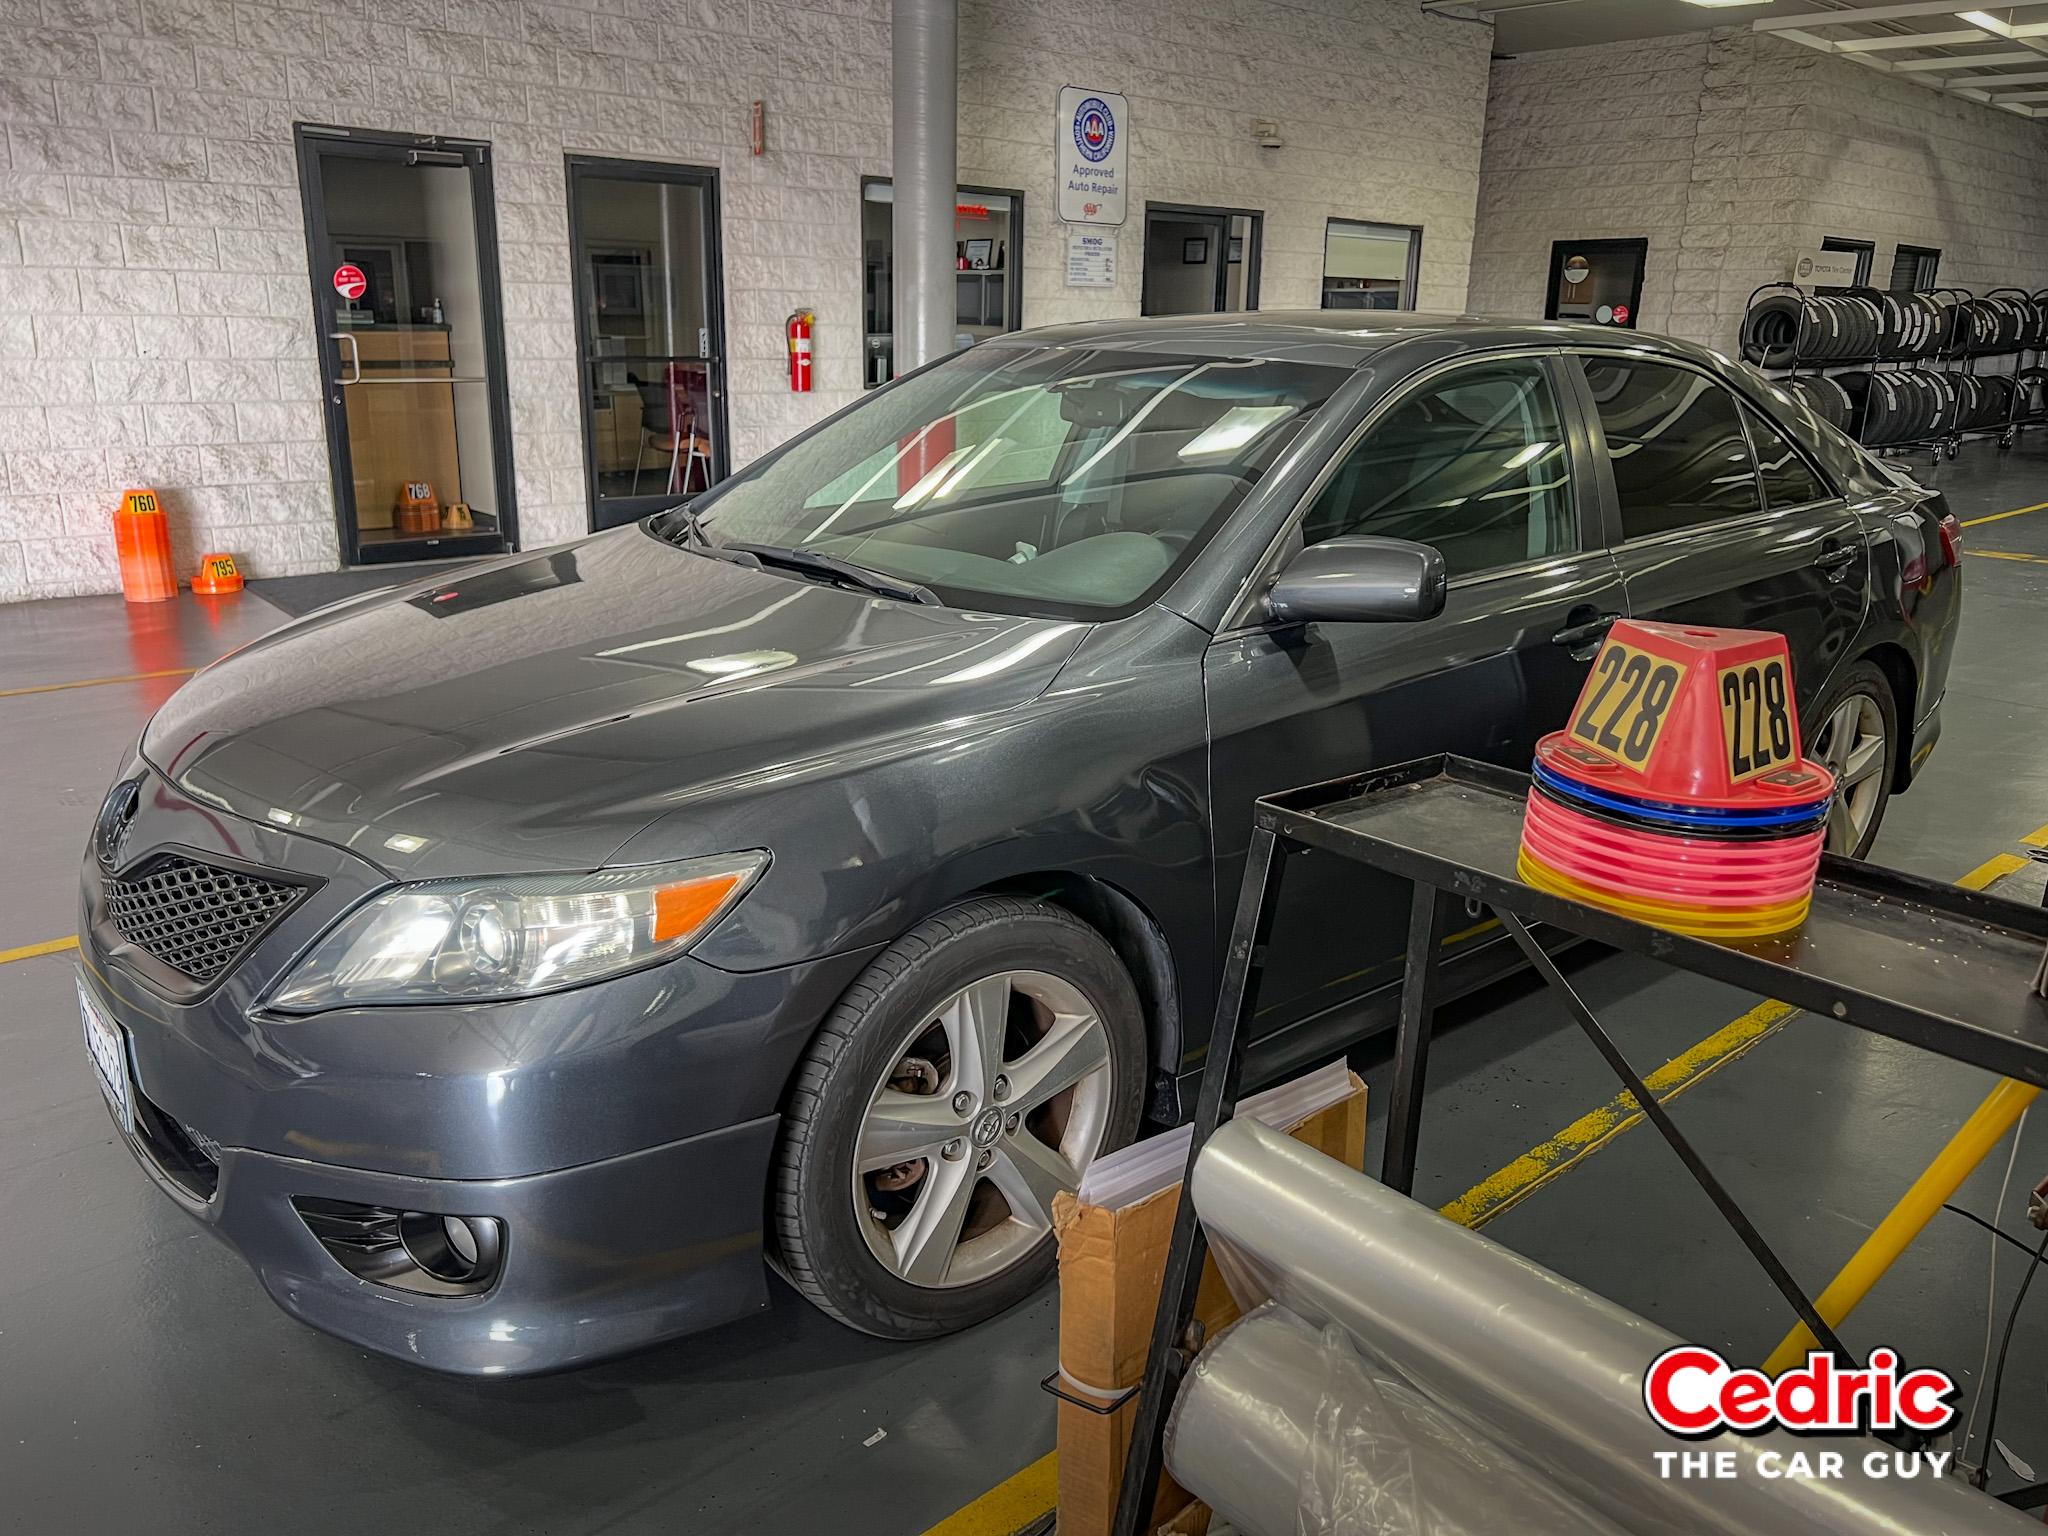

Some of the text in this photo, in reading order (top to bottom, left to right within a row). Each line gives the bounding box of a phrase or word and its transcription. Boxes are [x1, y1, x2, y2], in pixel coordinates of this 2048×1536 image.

[1085, 114, 1104, 137] AAA
[1073, 164, 1115, 178] Approved
[1068, 180, 1118, 196] Auto Repair
[1082, 237, 1103, 246] SMOG
[408, 483, 430, 500] 768
[129, 494, 156, 513] 760
[211, 559, 235, 578] 795
[1574, 645, 1680, 764] 228
[1723, 661, 1791, 777] 228
